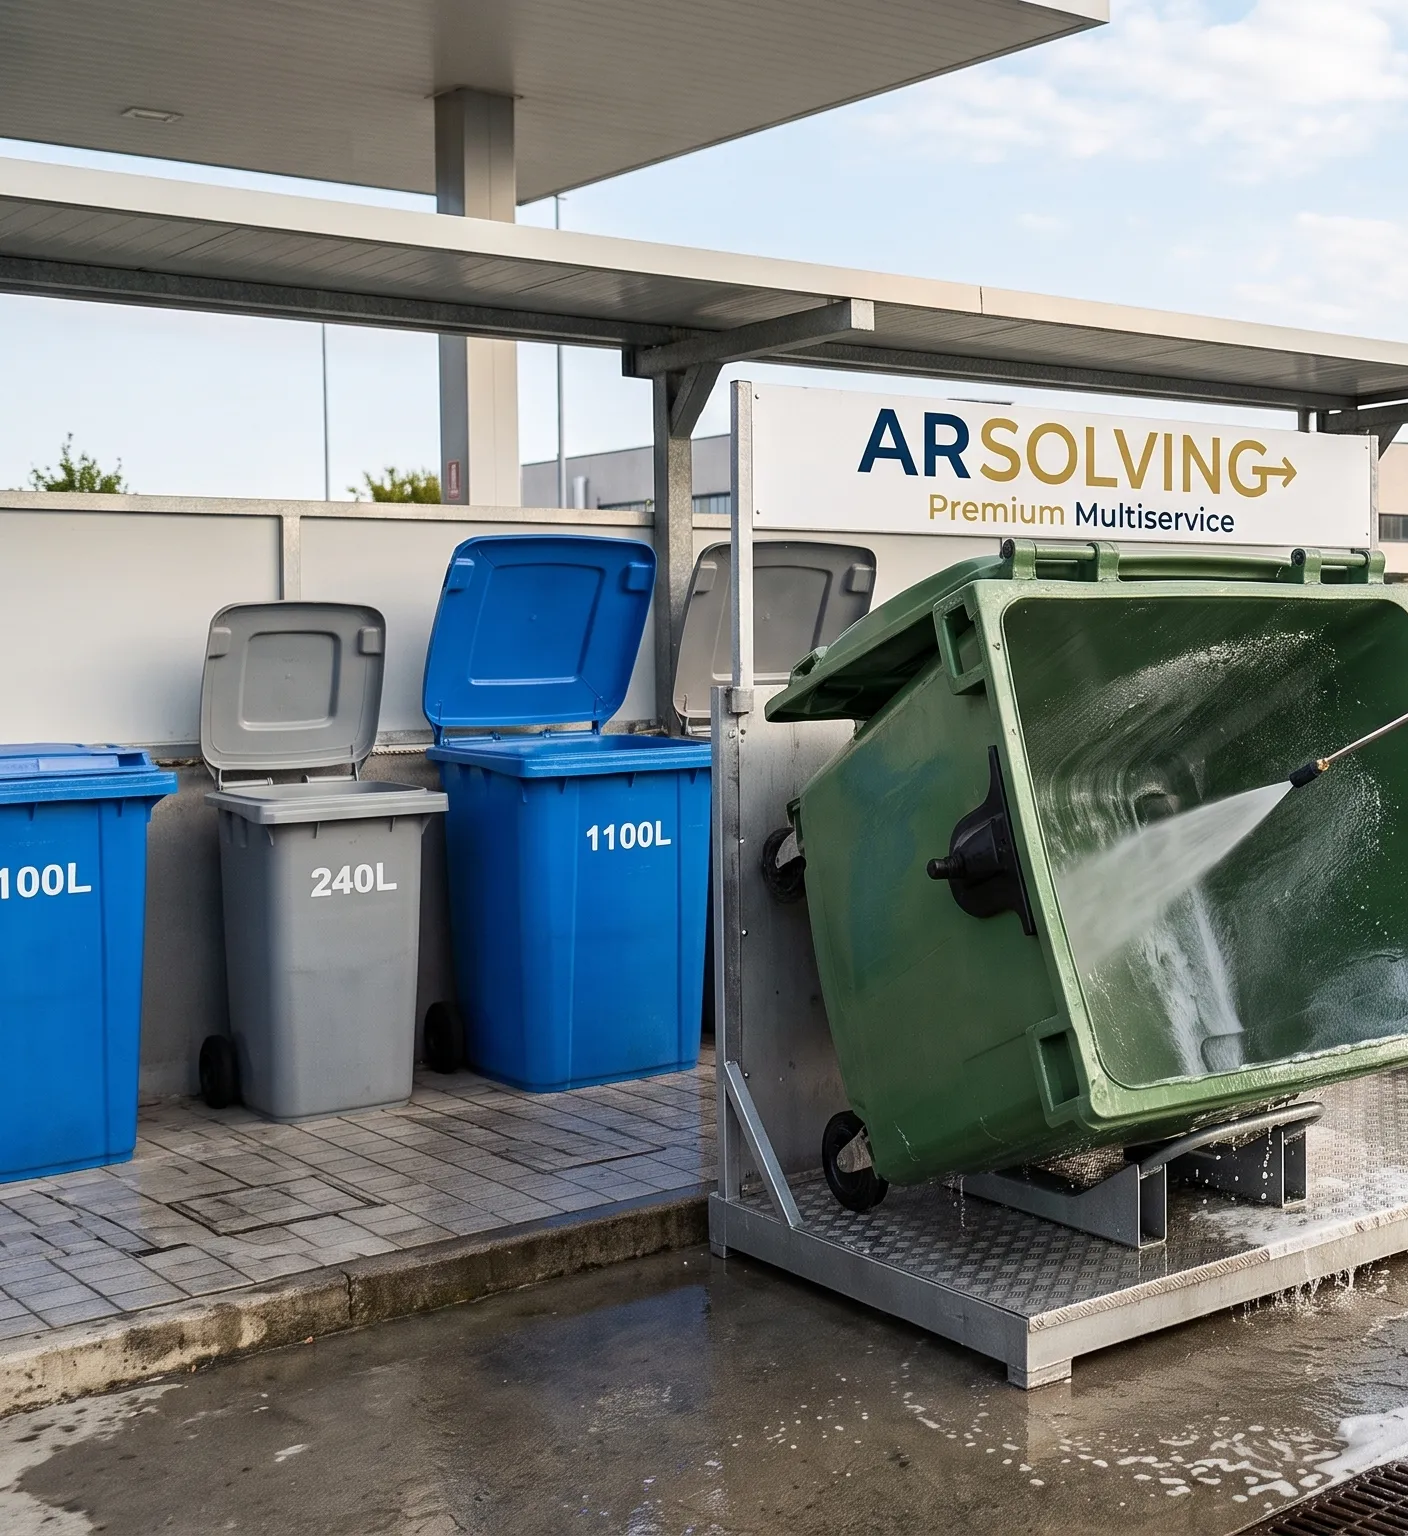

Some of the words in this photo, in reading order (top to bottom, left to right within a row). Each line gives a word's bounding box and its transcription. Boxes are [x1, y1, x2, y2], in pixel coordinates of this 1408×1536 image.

[857, 408, 1270, 498] ARSOLVING
[928, 494, 1066, 526] Premium
[1074, 501, 1235, 534] Multiservice
[586, 820, 672, 851] 1100L
[310, 862, 398, 898] 240L
